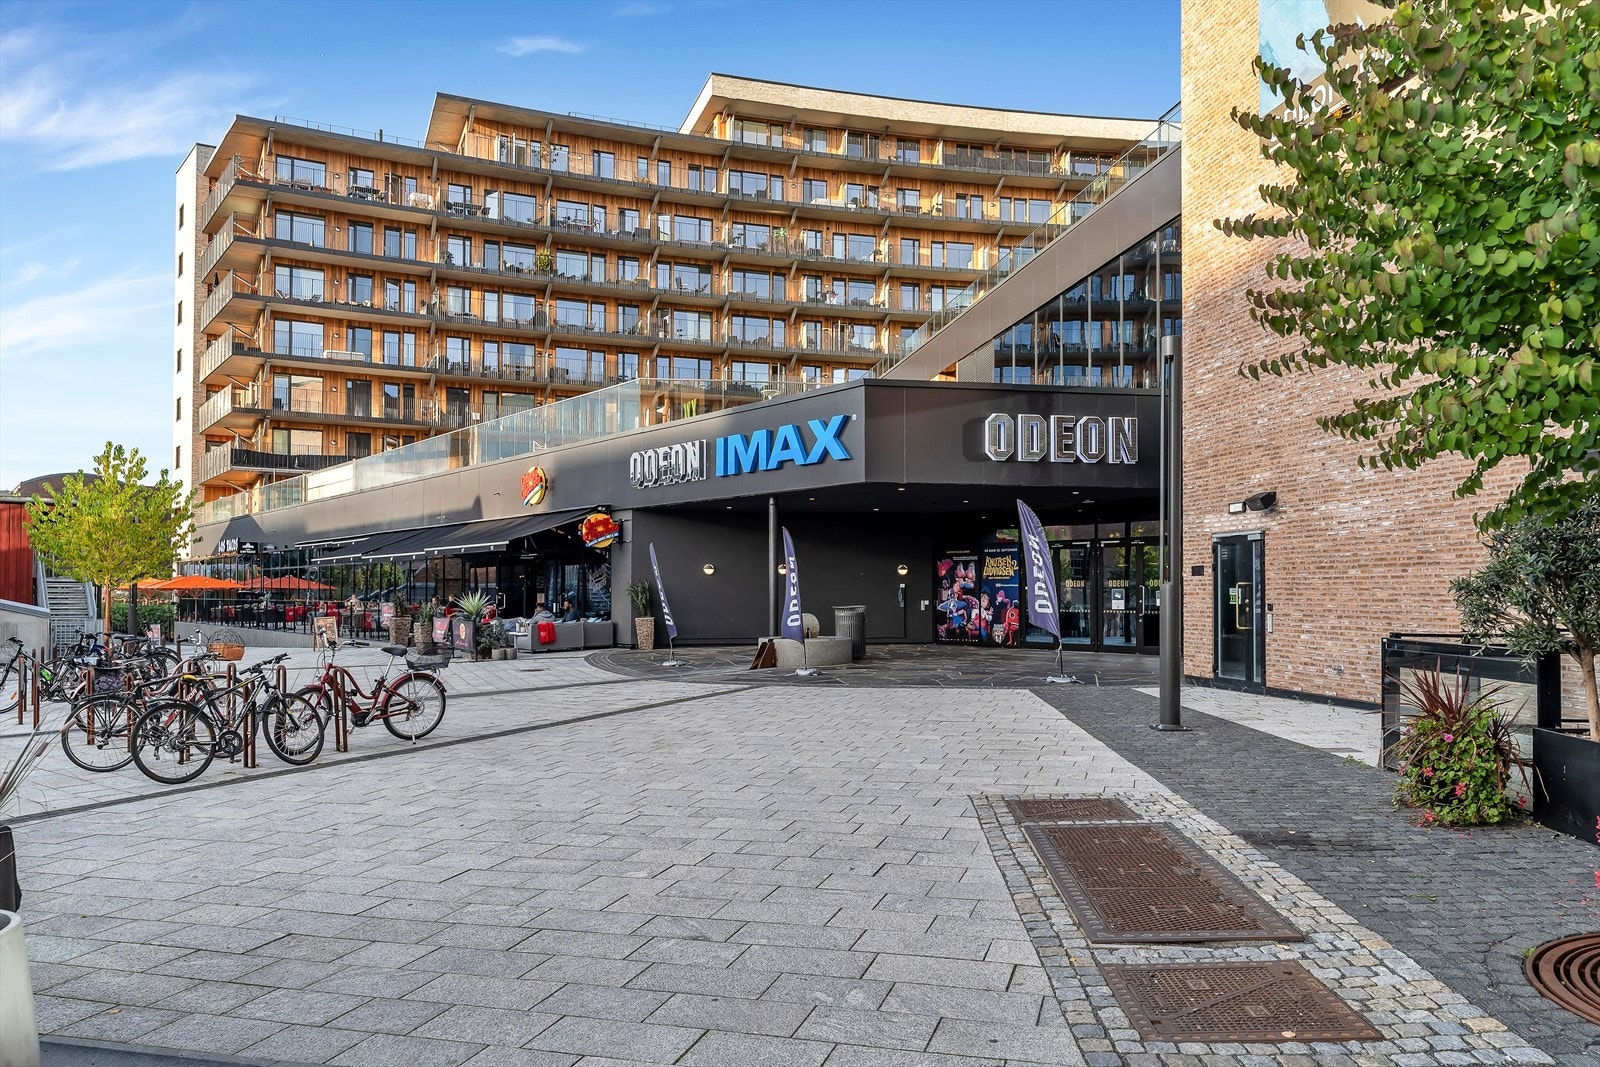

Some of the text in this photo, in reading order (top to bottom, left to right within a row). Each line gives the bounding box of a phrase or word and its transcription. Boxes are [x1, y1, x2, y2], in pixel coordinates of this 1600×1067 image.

[629, 414, 851, 489] ODEON IMAX
[985, 413, 1138, 464] ODEON
[1028, 534, 1053, 614] ODEON
[1065, 579, 1085, 588] ODEON
[1108, 579, 1129, 588] ODEON
